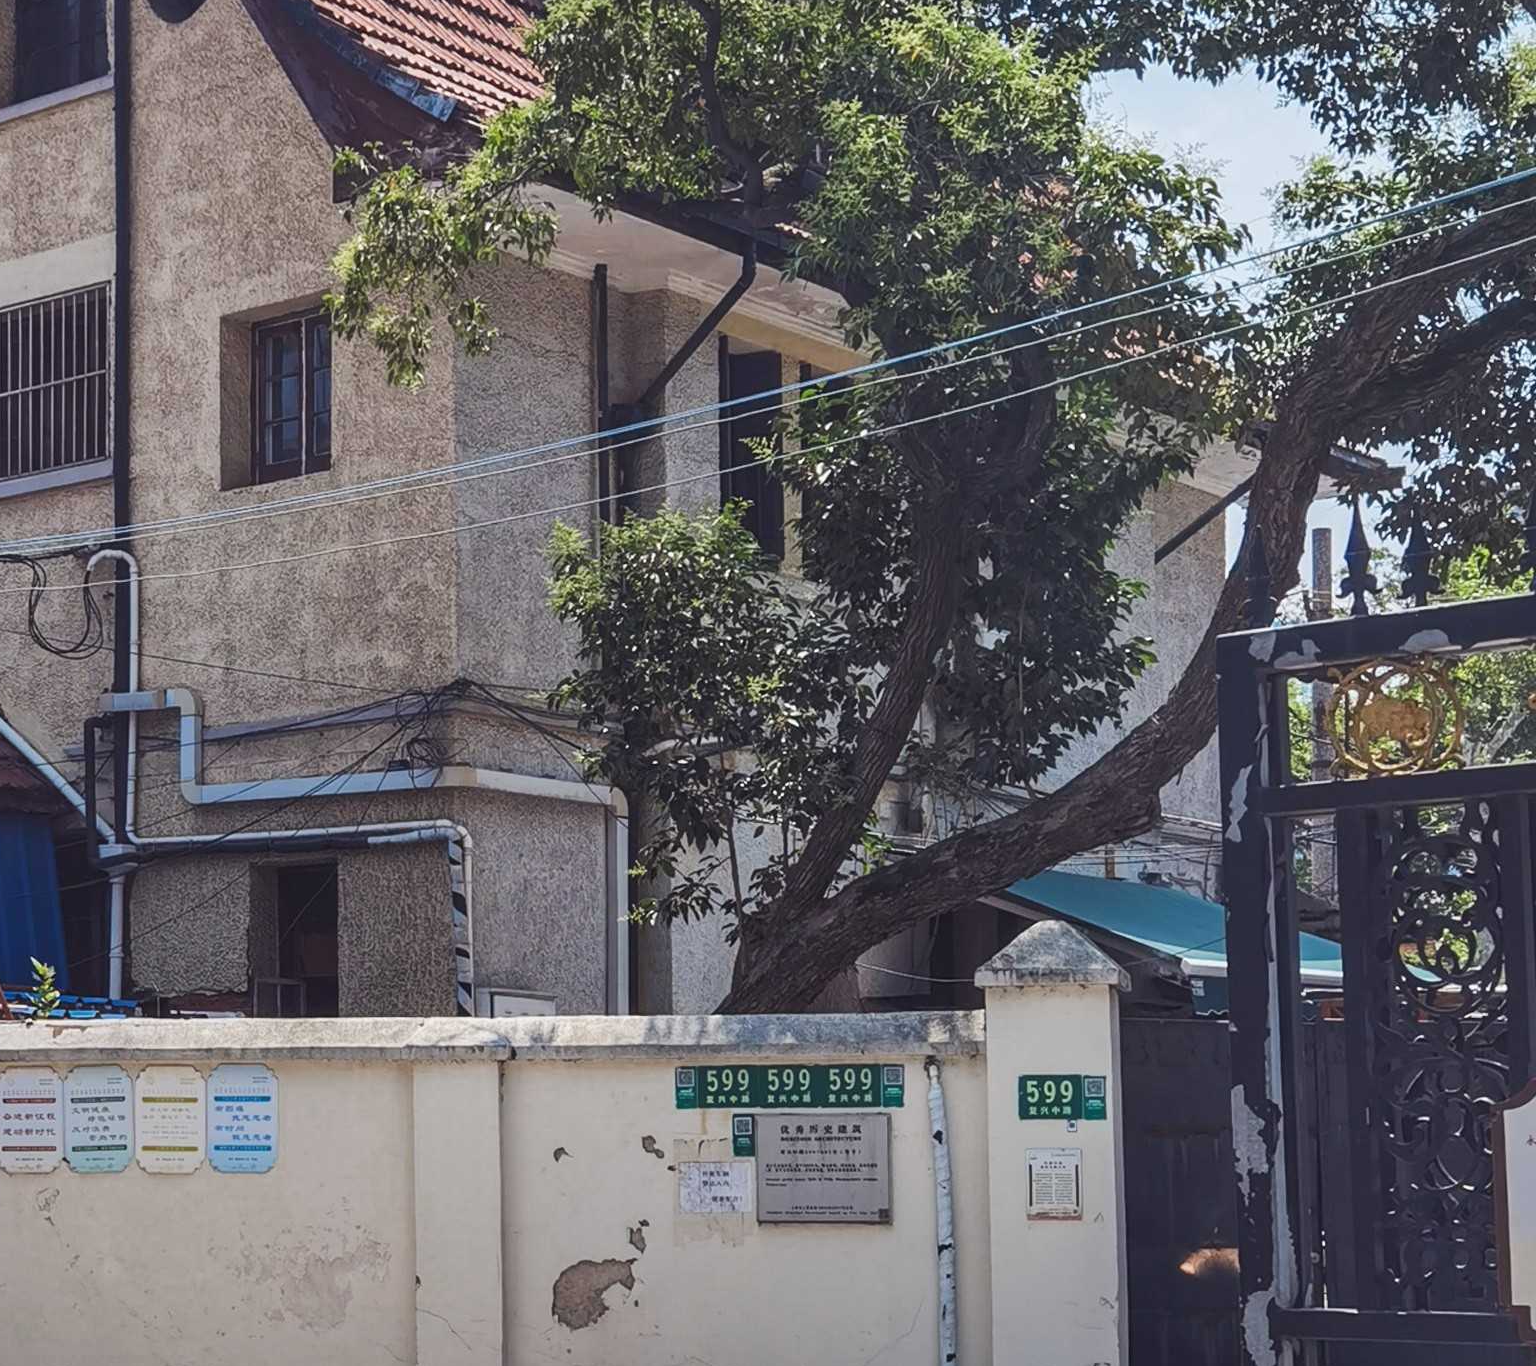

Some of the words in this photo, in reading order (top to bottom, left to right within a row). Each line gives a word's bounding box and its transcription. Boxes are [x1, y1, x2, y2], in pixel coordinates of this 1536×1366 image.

[706, 1068, 750, 1092] 599
[767, 1068, 811, 1091] 599
[828, 1067, 872, 1091] 599
[706, 1093, 750, 1104] 复兴中路
[767, 1093, 811, 1103] 复兴中路
[828, 1093, 872, 1103] 复兴中路
[1026, 1080, 1073, 1103] 599
[1028, 1106, 1072, 1116] 复兴中路
